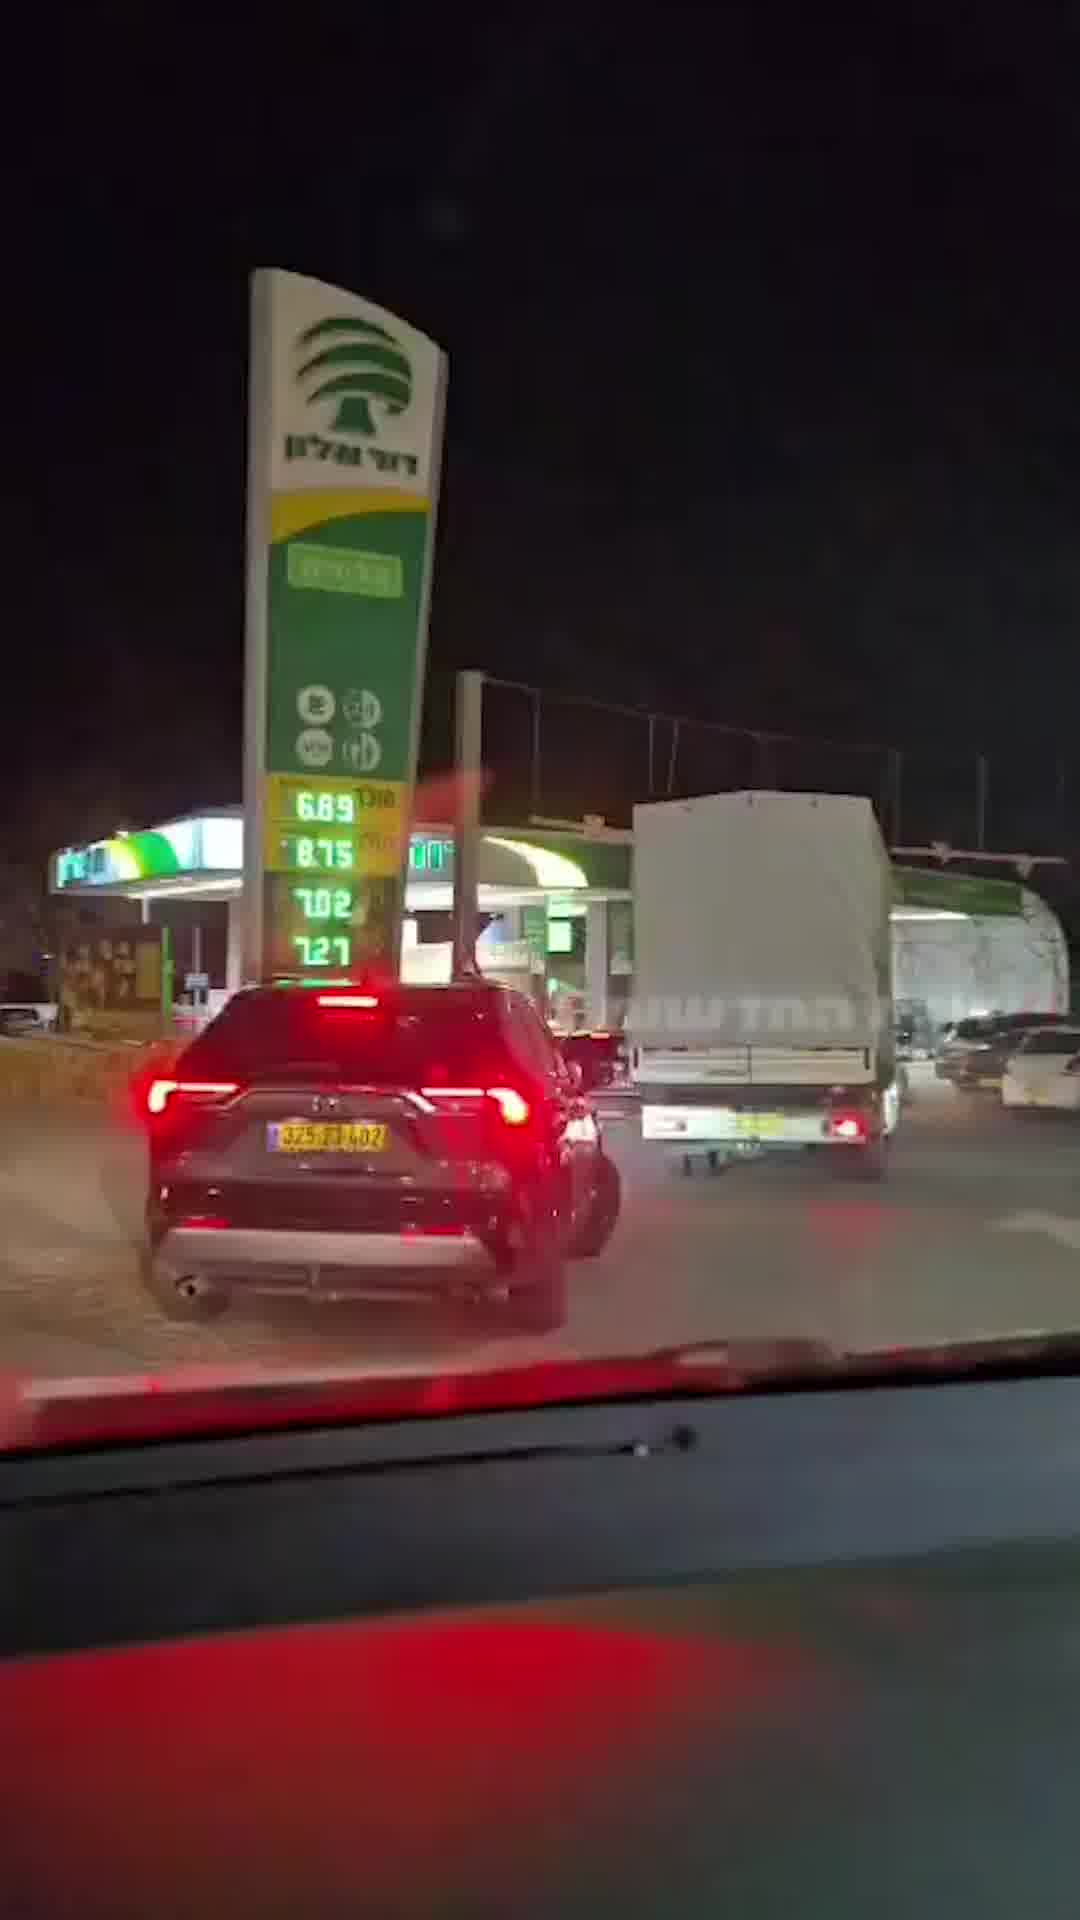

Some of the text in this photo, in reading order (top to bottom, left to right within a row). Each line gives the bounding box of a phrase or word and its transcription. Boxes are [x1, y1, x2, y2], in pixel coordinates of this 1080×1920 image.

[285, 433, 417, 475] דור אלון
[297, 837, 353, 869] 8.75
